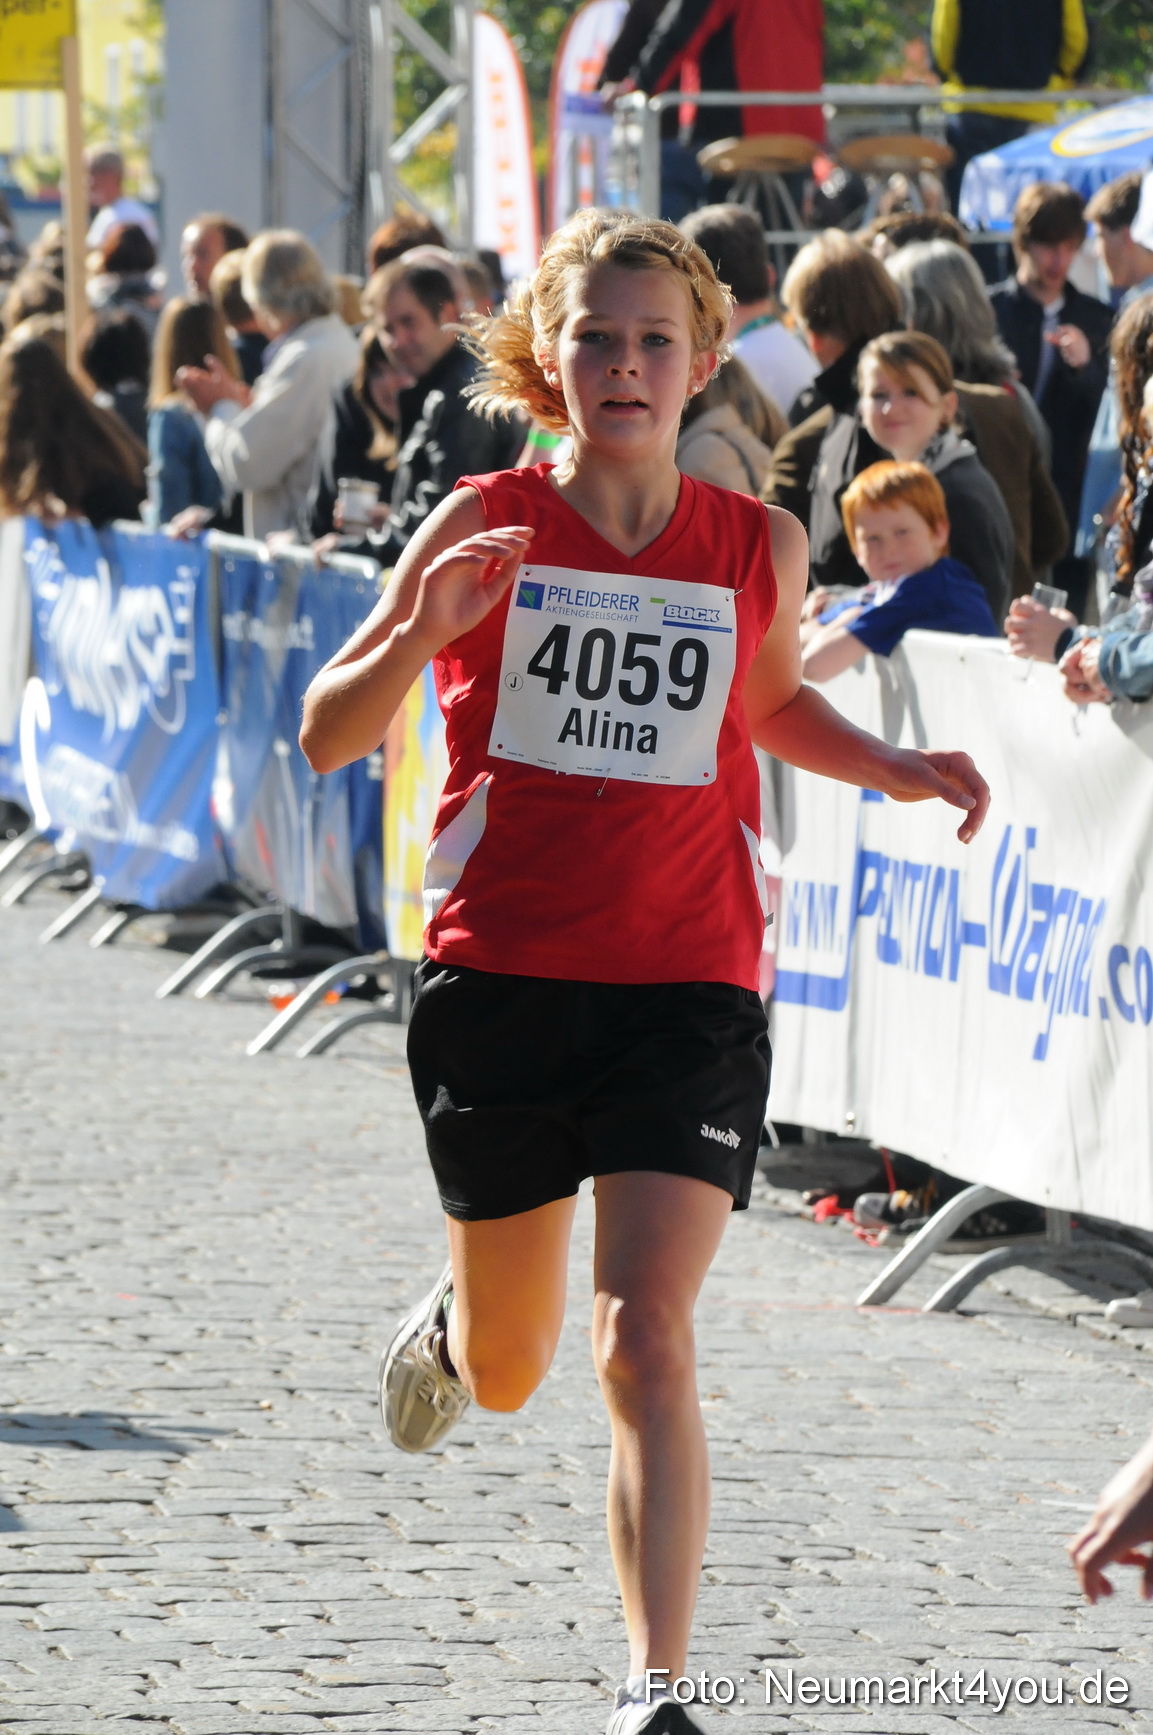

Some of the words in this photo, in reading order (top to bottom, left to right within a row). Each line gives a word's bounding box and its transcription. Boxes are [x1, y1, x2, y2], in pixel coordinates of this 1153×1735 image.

[547, 585, 640, 612] PFLEIDERER
[545, 605, 639, 623] AKTIENGESELLSCHAFT
[663, 604, 721, 623] BOCK
[526, 623, 709, 711] 4059
[557, 707, 659, 755] Alina
[700, 1123, 733, 1148] JAKO
